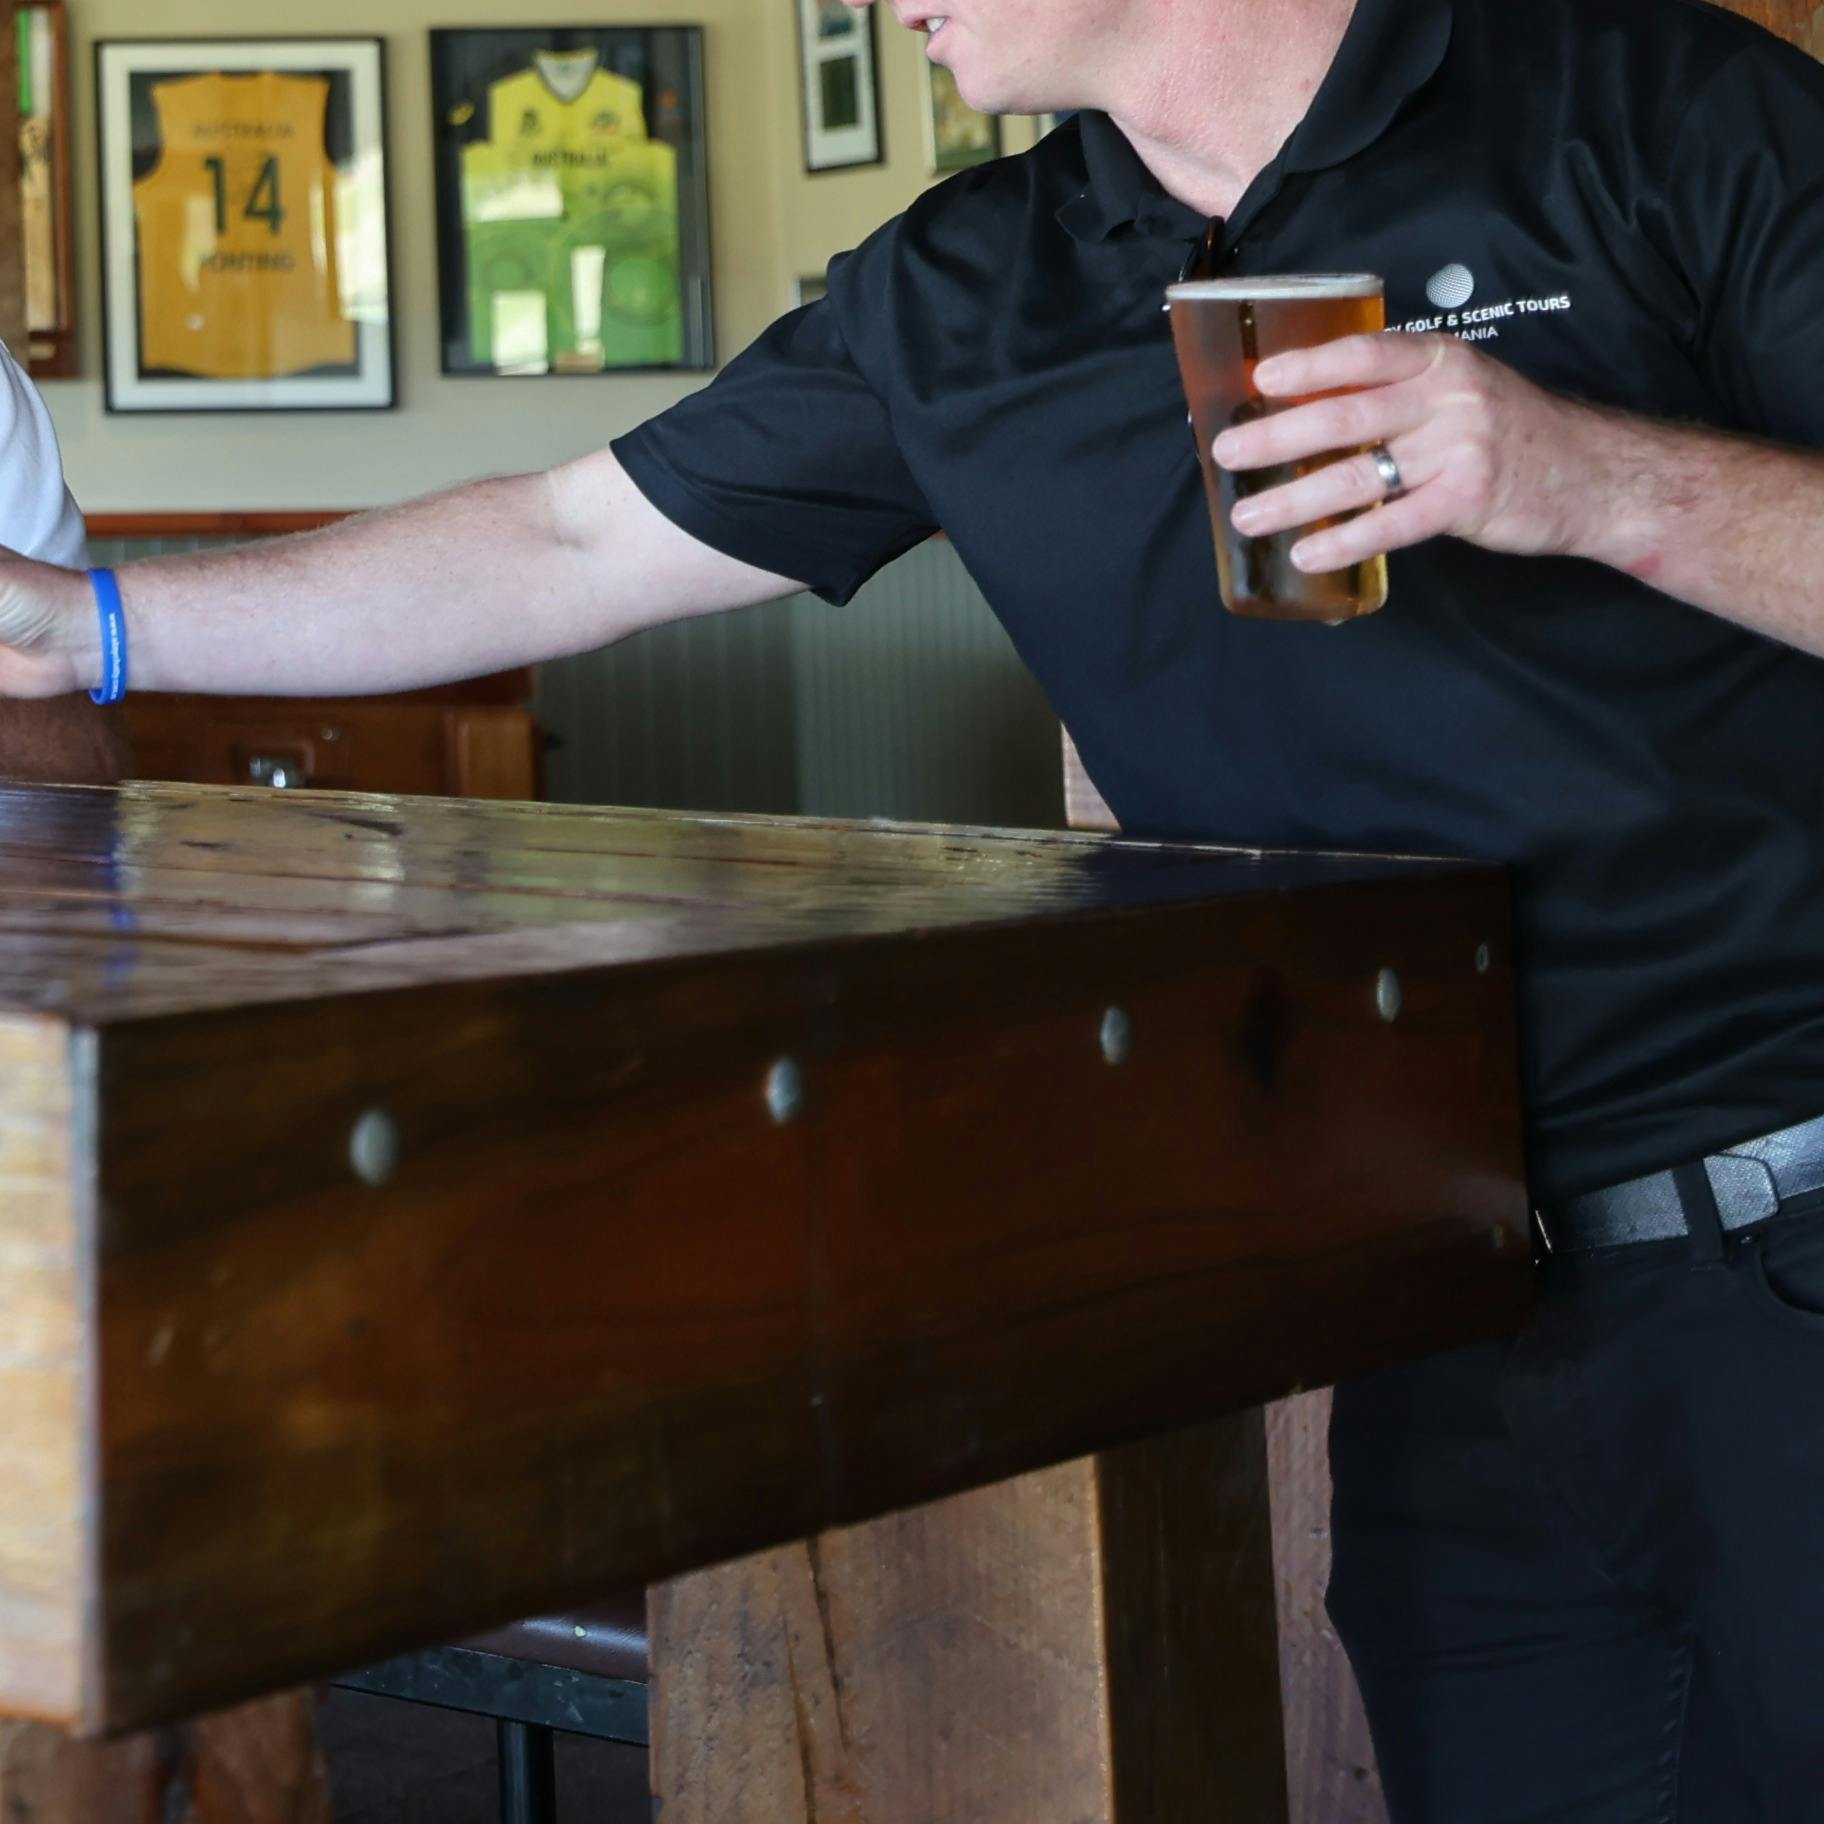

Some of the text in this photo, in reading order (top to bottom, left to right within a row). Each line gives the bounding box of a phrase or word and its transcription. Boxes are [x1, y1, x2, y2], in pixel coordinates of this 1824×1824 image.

[204, 153, 286, 235] 14
[1405, 315, 1444, 333] GOLF
[1446, 313, 1459, 327] &
[1461, 301, 1515, 324] SCENIC
[1515, 295, 1571, 314] TOURS
